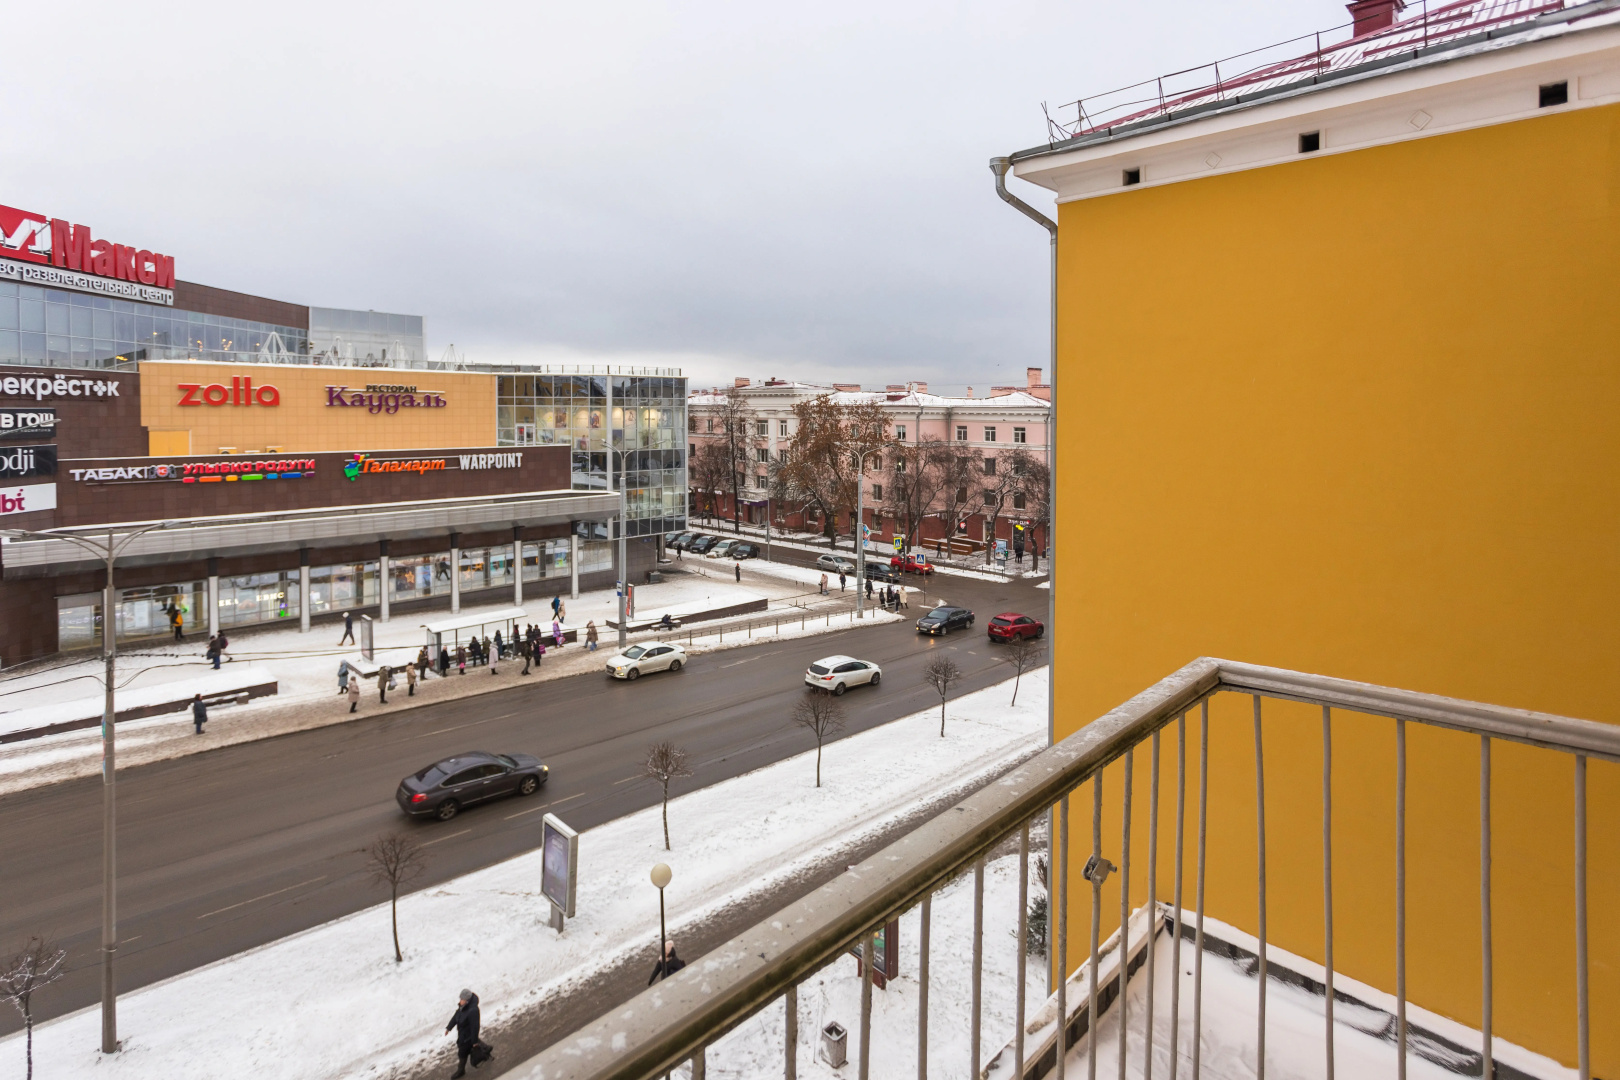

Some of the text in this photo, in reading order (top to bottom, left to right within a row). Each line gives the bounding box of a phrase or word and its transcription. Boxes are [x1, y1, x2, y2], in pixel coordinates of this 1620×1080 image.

[51, 218, 175, 289] Макси
[141, 288, 174, 306] центр
[177, 375, 280, 406] zolla
[366, 384, 417, 393] РЕСТОРАН
[325, 385, 447, 414] Каудаль
[363, 458, 446, 475] Галамарт
[459, 452, 523, 471] WARPOINT
[69, 467, 143, 482] ТАБАК
